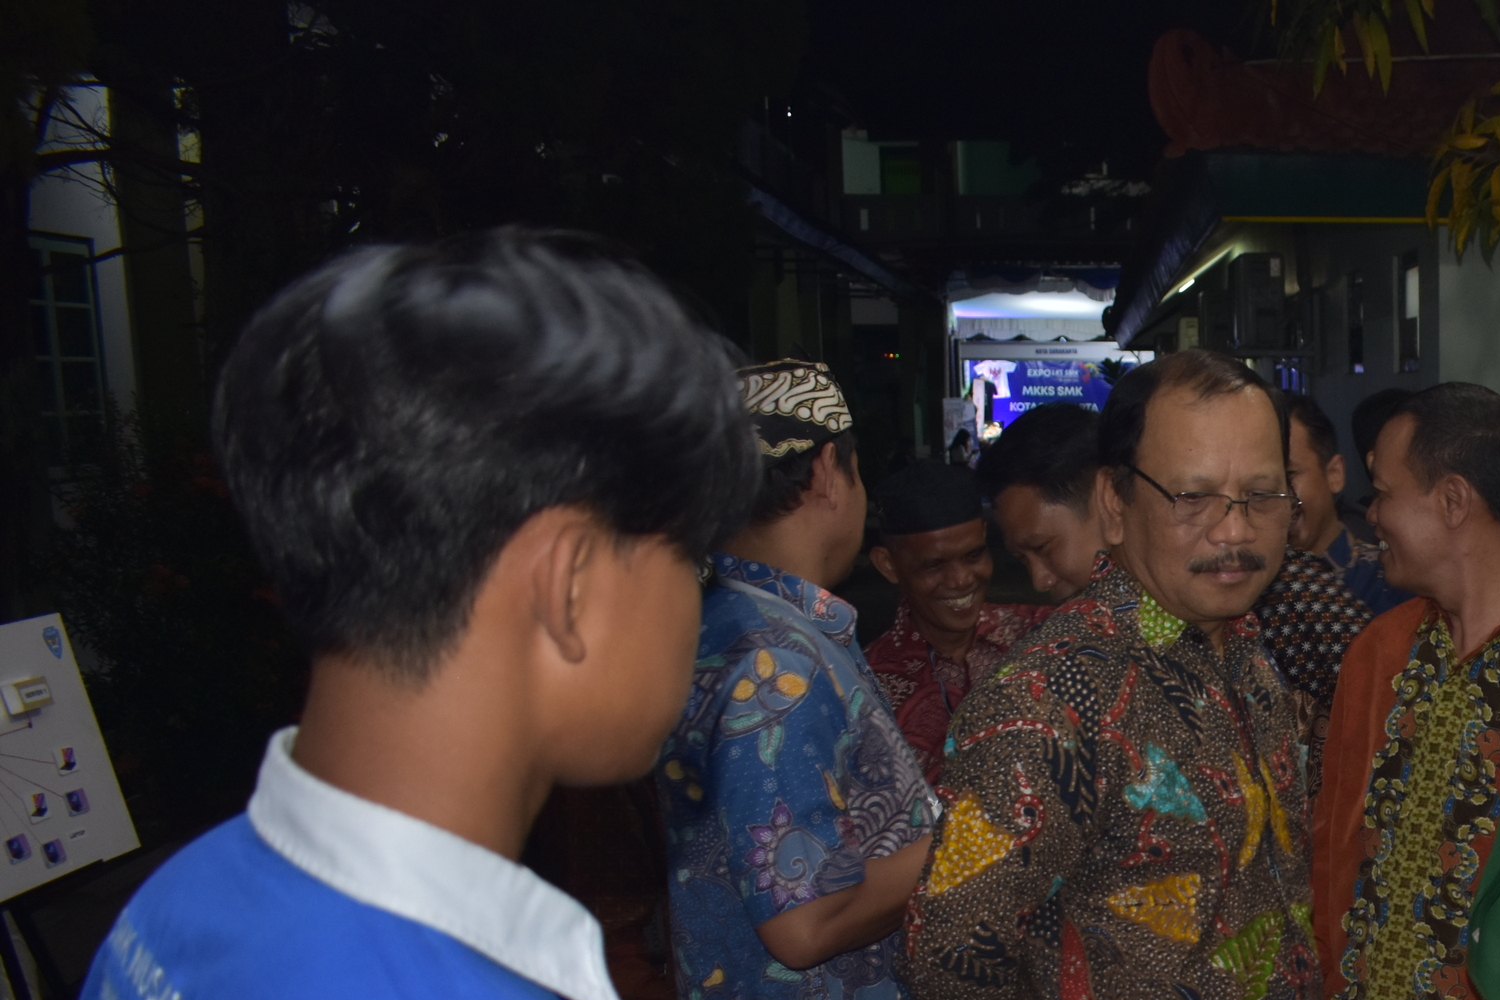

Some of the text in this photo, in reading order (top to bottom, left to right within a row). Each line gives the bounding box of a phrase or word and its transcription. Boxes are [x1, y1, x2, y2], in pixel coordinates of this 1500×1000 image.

[1027, 369, 1051, 377] EXPO
[1022, 386, 1083, 396] MKKS SMK
[1009, 401, 1037, 412] KOTA
